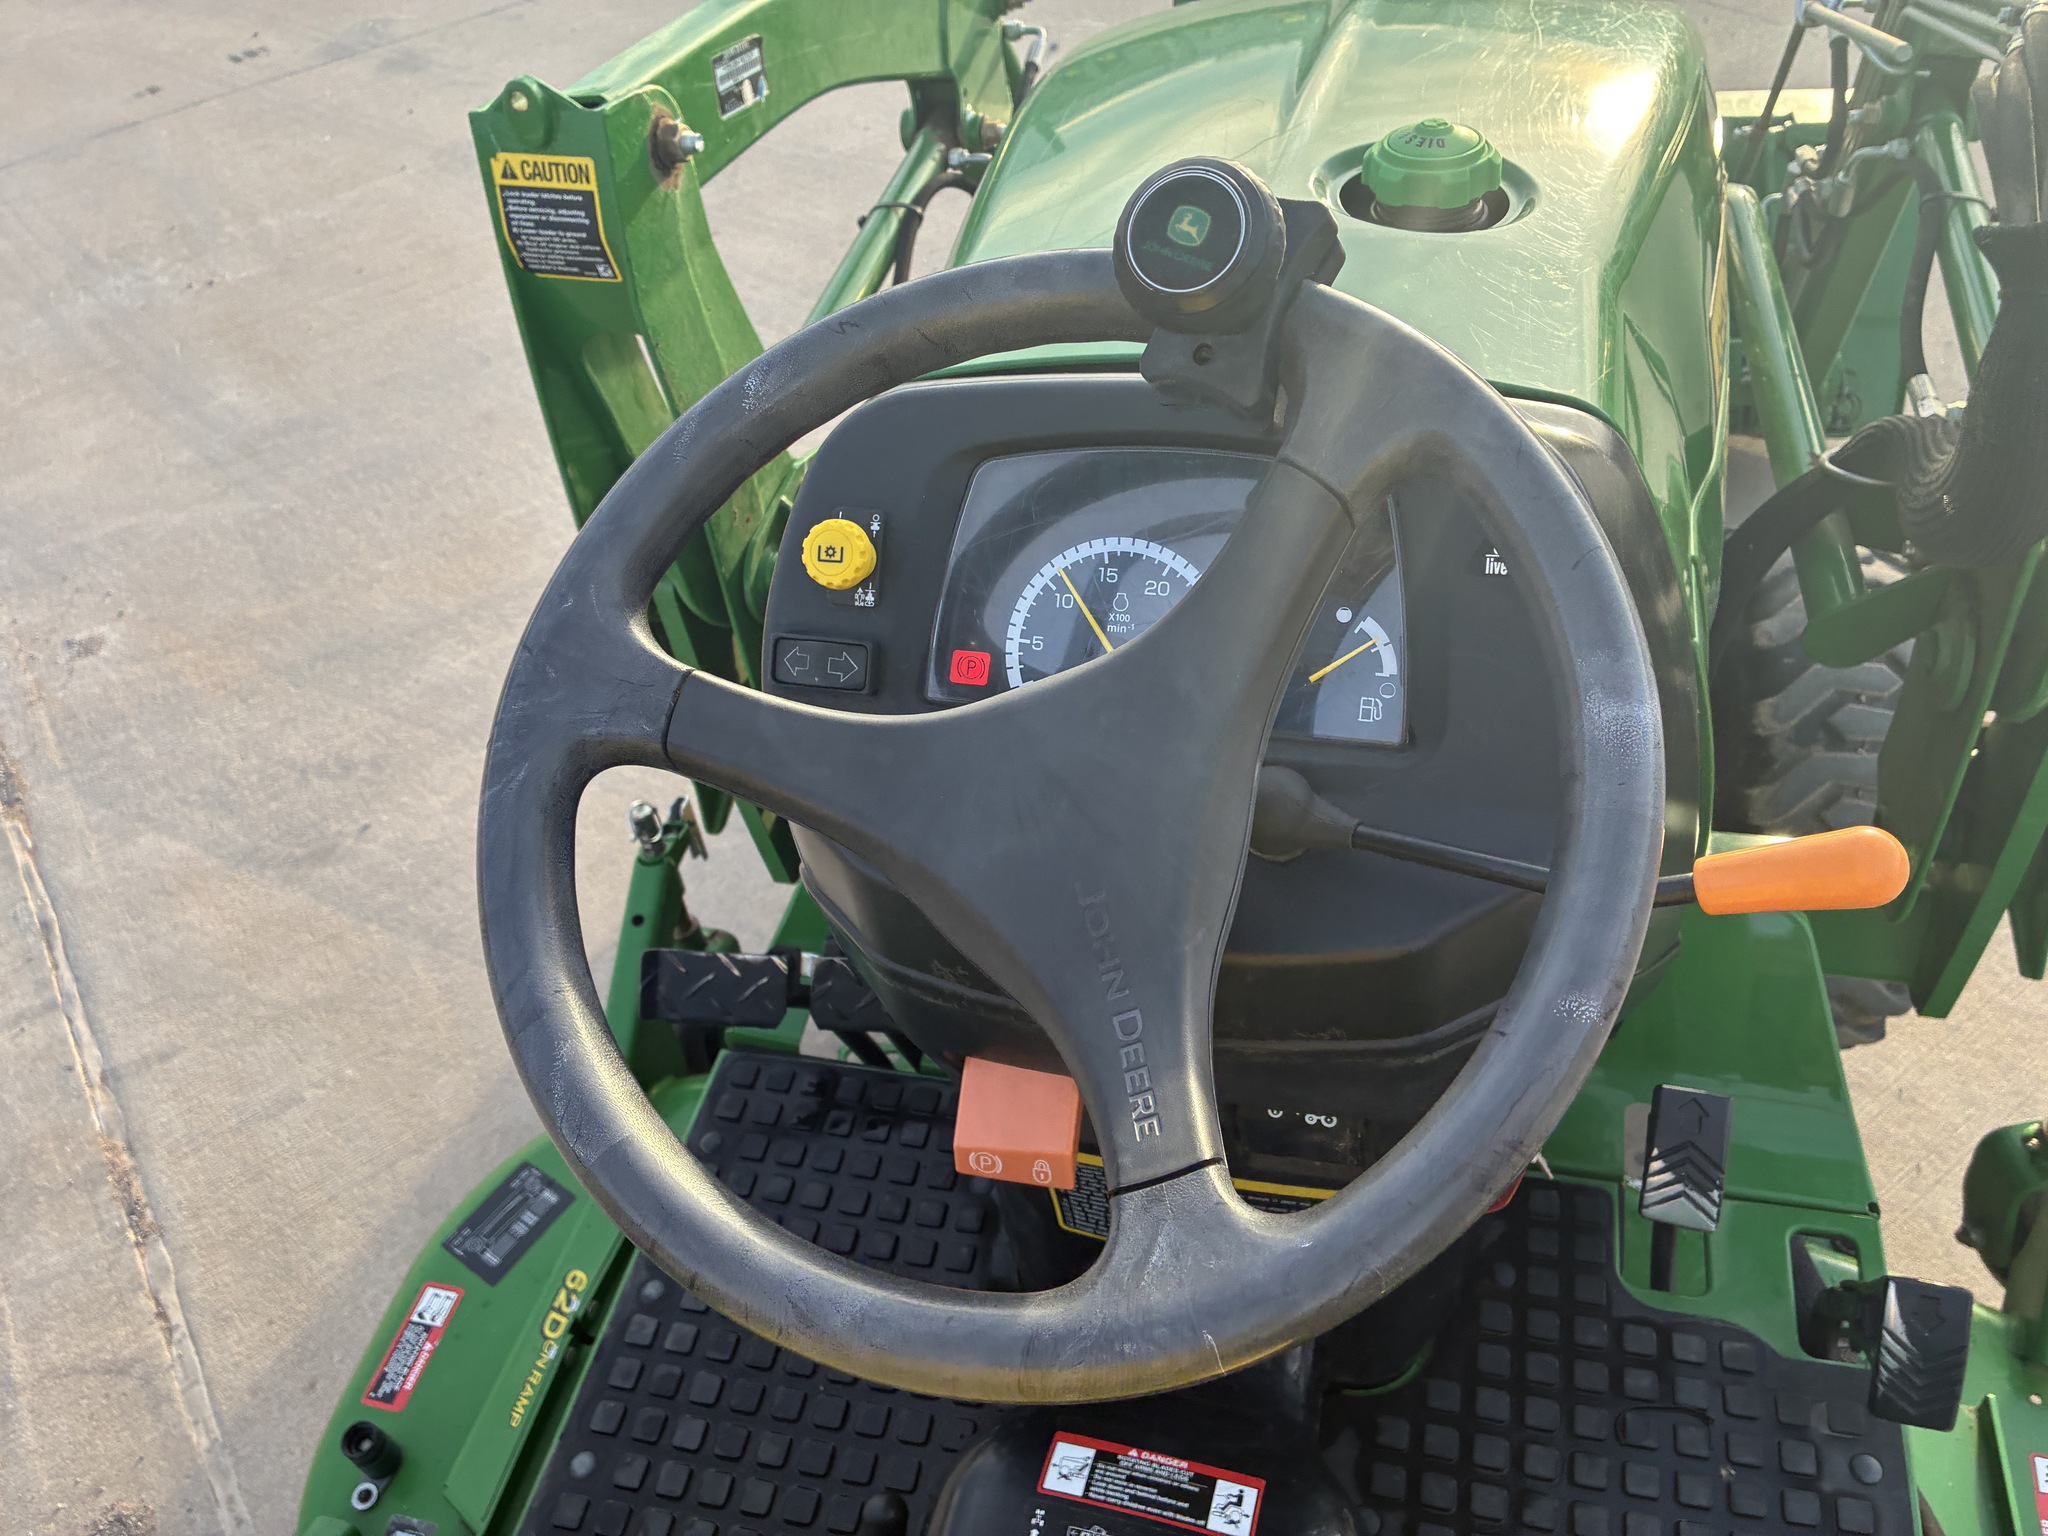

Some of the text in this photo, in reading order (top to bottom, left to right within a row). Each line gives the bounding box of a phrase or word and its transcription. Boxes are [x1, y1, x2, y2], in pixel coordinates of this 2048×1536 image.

[521, 160, 590, 184] CAUTION
[1098, 567, 1118, 583] 15
[1144, 580, 1170, 597] 20
[1054, 593, 1074, 609] 10
[1108, 613, 1131, 622] X100
[1031, 636, 1044, 651] 5
[966, 660, 977, 675] P
[1074, 881, 1163, 1142] JOHN DEERE
[980, 1156, 992, 1169] P
[541, 1268, 589, 1340] 62D
[403, 1350, 431, 1391] DANGER
[509, 1368, 544, 1428] RAMP
[1141, 1451, 1189, 1469] DANGER
